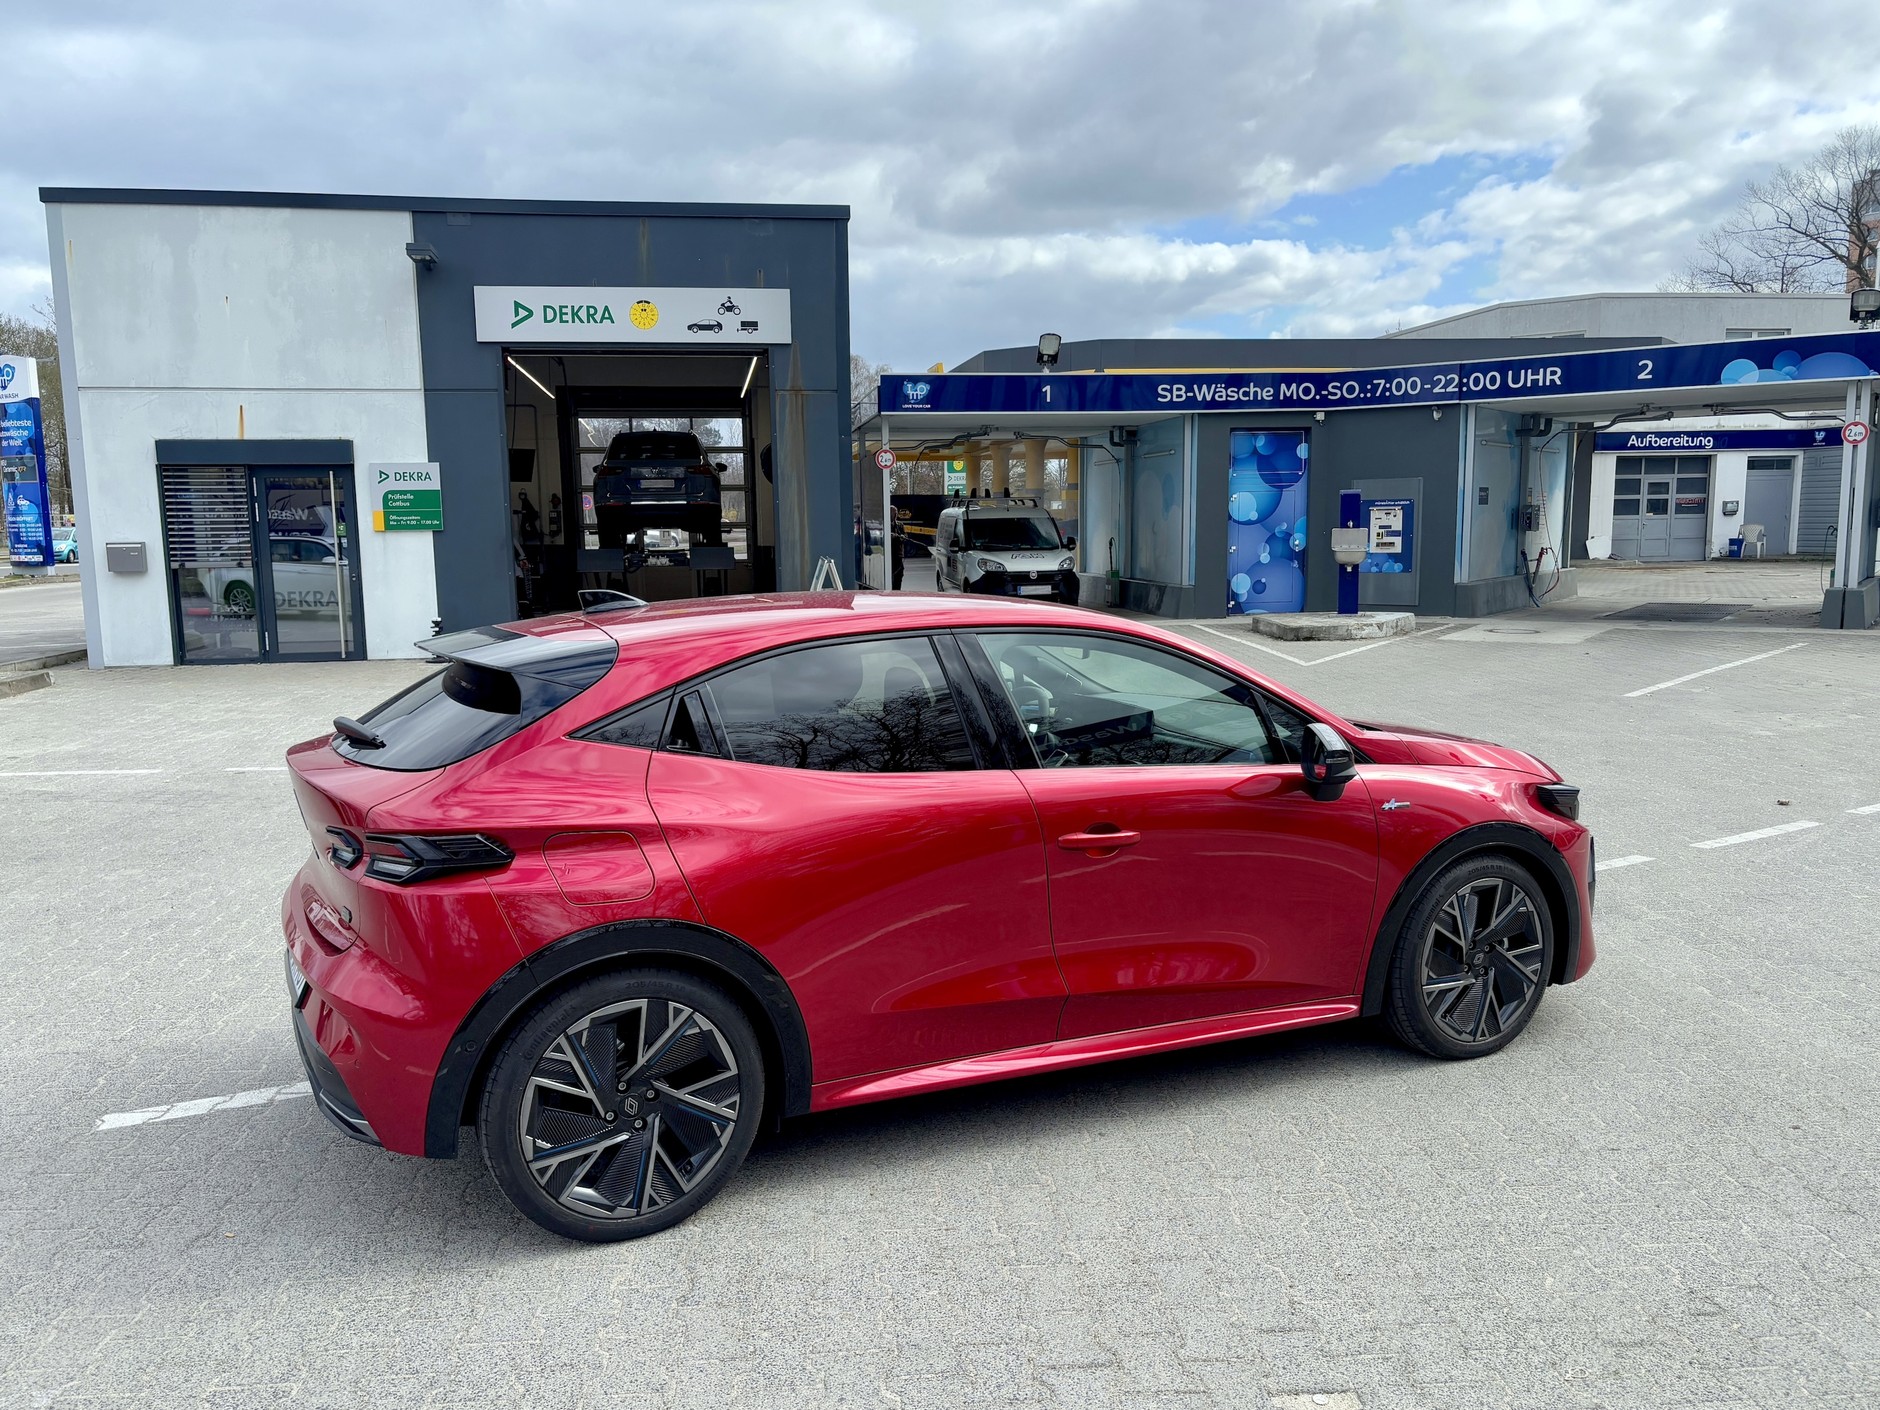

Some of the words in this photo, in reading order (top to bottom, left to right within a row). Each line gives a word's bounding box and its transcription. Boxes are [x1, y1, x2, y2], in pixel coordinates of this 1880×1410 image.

[543, 305, 615, 324] DEKRA
[1637, 360, 1653, 380] 2
[1042, 385, 1051, 402] 1
[1157, 383, 1274, 402] SB-Wäsche
[1507, 367, 1562, 389] UHR
[1627, 434, 1713, 449] Aufbereitung
[394, 471, 432, 481] DEKRA
[274, 590, 339, 608] DEKRA
